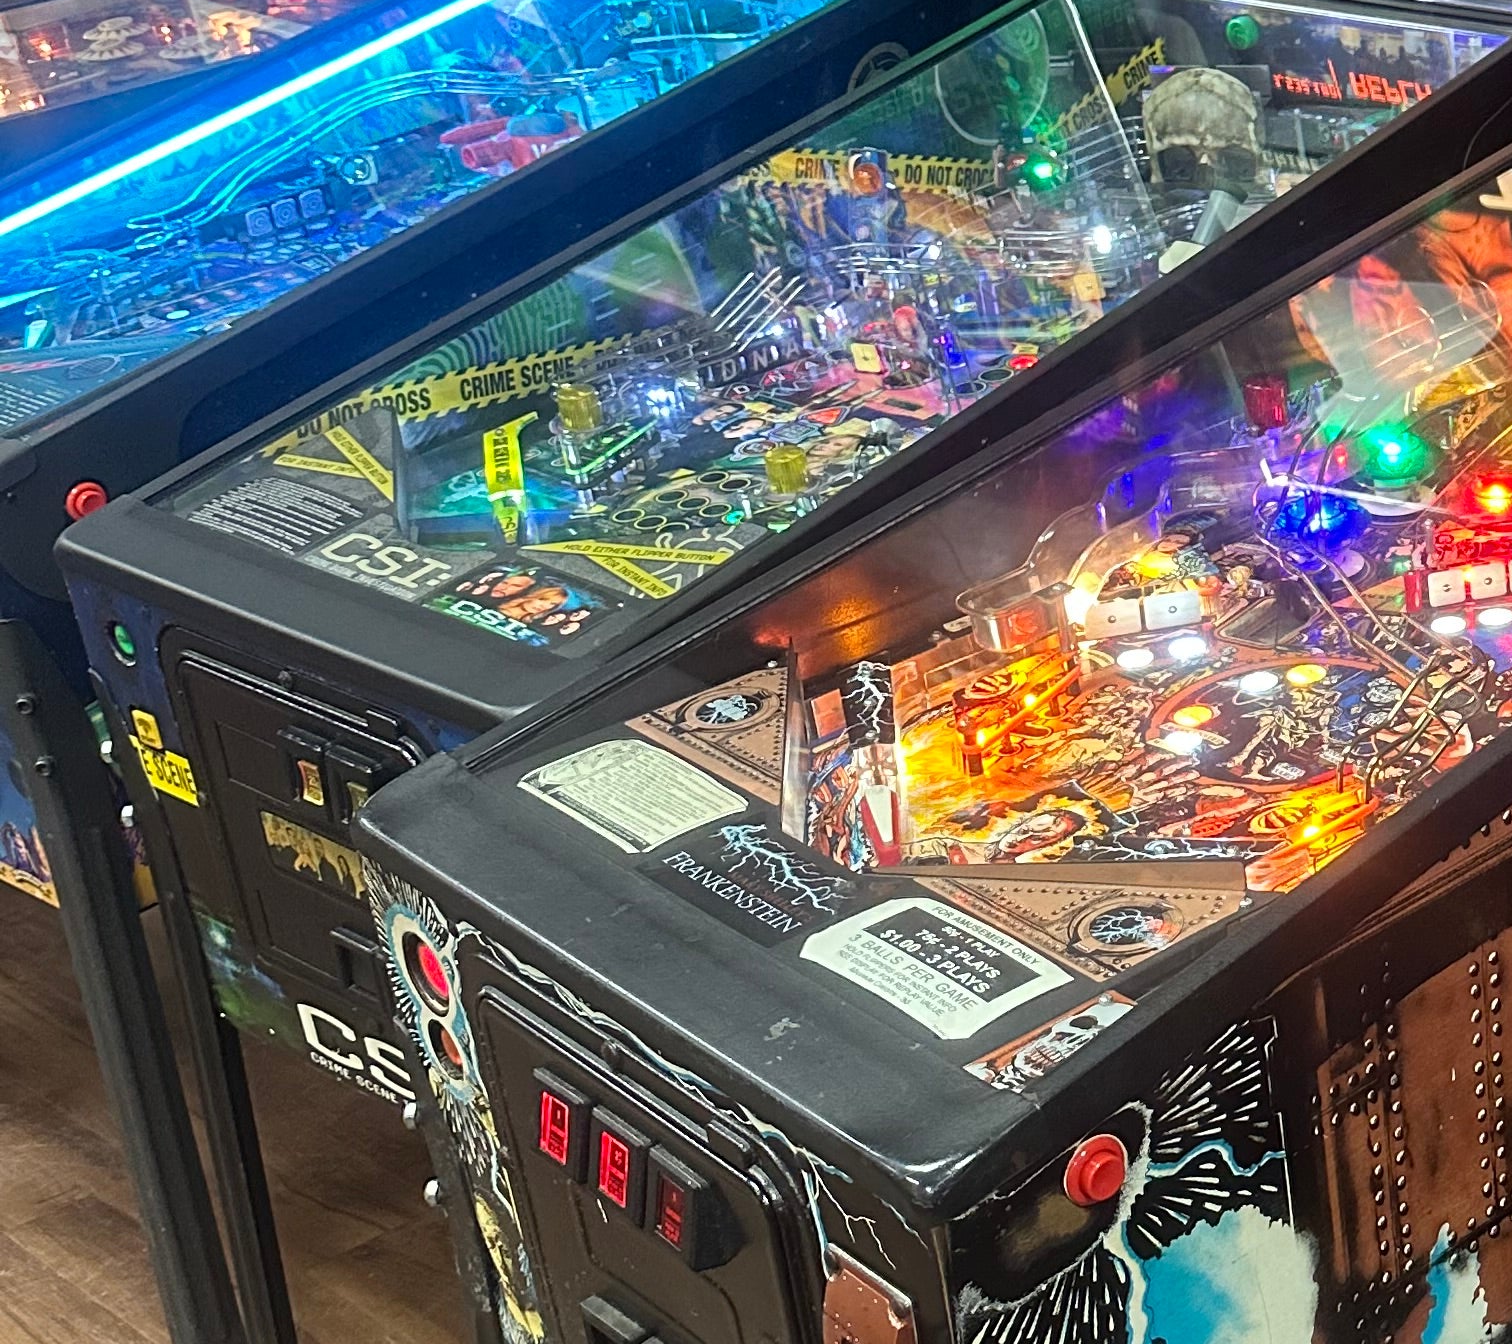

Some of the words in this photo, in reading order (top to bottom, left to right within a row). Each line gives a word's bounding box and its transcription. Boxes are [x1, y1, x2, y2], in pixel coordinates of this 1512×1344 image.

[904, 166, 922, 185] DO
[926, 166, 952, 187] NOT
[459, 370, 516, 402] CRIME
[521, 356, 576, 388] SCENE
[319, 532, 452, 590] CSI:
[563, 543, 591, 553] HOLD
[592, 544, 630, 556] EITHER
[631, 548, 674, 559] FLIPPER
[674, 551, 716, 562] BUTTON
[617, 561, 650, 587] INSTANT
[152, 753, 196, 794] SCENE
[661, 849, 803, 934] FRANKENSTEIN
[931, 905, 956, 918] FOR
[953, 915, 1011, 951] AMUSEMENT
[1010, 946, 1041, 966] ONLY
[970, 940, 1001, 959] PLAY
[848, 933, 862, 943] 3
[861, 939, 905, 966] BALLS
[903, 963, 935, 984] PER
[935, 981, 979, 1012] GAME
[879, 928, 922, 954] $1.00
[925, 954, 942, 965] 3
[937, 959, 991, 994] PLAYS
[944, 944, 959, 955] 2
[955, 948, 1002, 979] PLAYS
[310, 1051, 352, 1080] CRIME
[355, 1074, 400, 1105] SCENE
